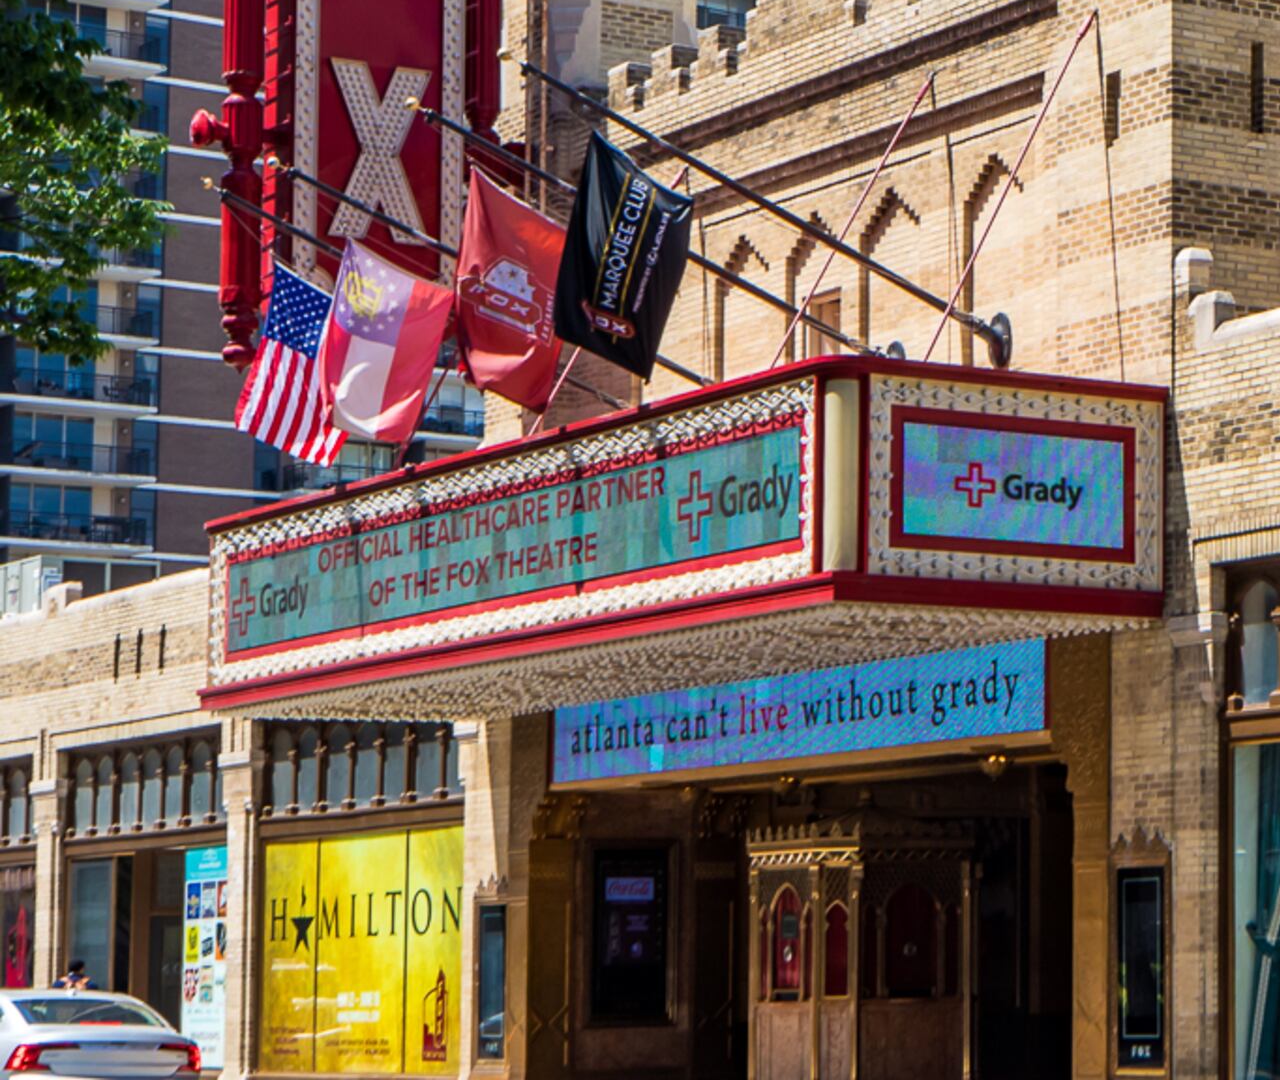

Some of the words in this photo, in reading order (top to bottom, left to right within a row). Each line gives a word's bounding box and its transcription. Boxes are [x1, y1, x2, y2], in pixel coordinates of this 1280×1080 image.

[600, 222, 636, 309] MARQUEE
[623, 178, 649, 223] CLUB
[469, 284, 530, 317] FOX
[594, 315, 627, 334] OX
[318, 530, 403, 573] OFFICIAL
[409, 493, 549, 553] HEALTHCARE
[556, 467, 666, 518] PARTNER
[719, 464, 793, 518] Grady
[1003, 474, 1083, 511] Grady
[259, 576, 309, 619] Grady
[369, 577, 396, 607] OF
[401, 566, 440, 601] THE
[447, 556, 489, 591] FOX
[496, 533, 598, 578] THEATRE
[571, 718, 655, 756] atlanta
[666, 697, 729, 743] can't
[739, 694, 789, 736] live
[802, 680, 917, 728] without
[931, 660, 1020, 726] grady
[270, 885, 463, 953] HAMILTON
